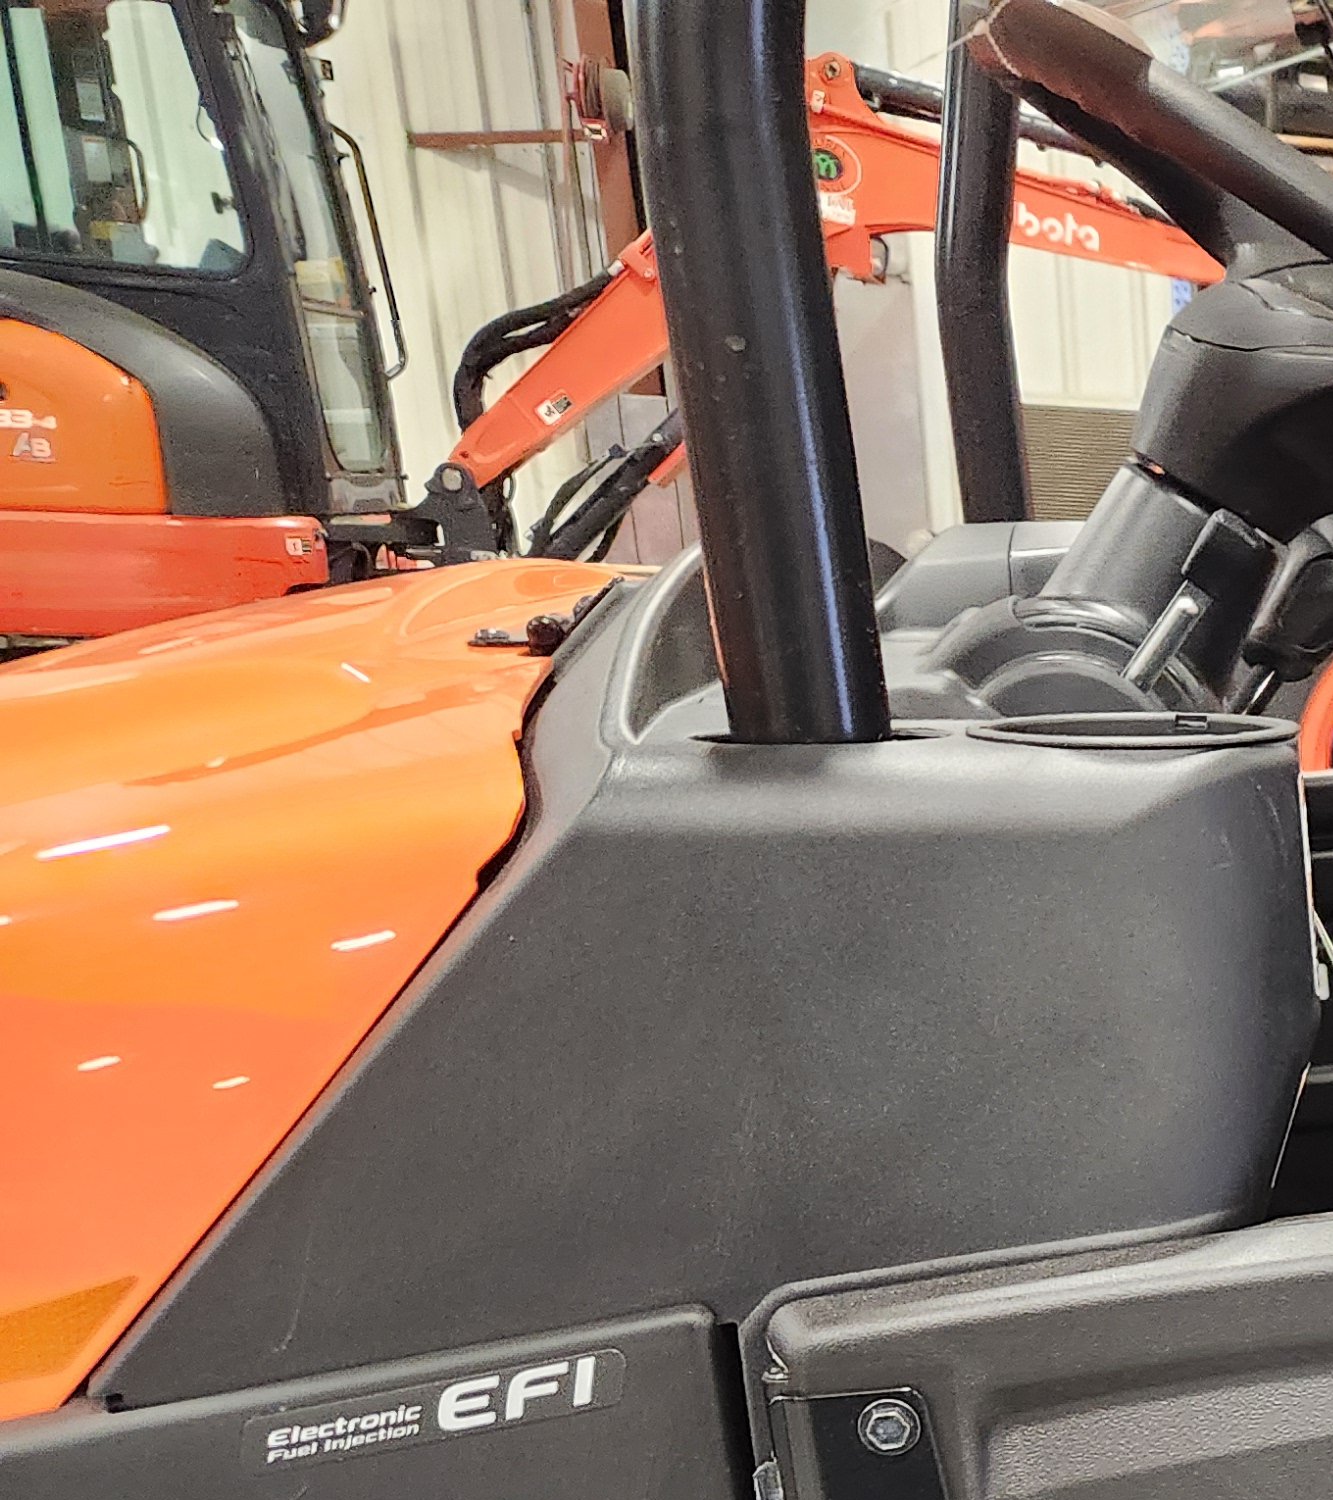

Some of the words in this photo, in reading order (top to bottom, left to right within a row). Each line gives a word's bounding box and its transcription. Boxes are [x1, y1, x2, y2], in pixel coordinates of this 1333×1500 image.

[438, 1355, 596, 1432] EFI
[266, 1404, 422, 1449] Electronic
[266, 1437, 318, 1465] Fuel
[323, 1423, 420, 1453] Injection
